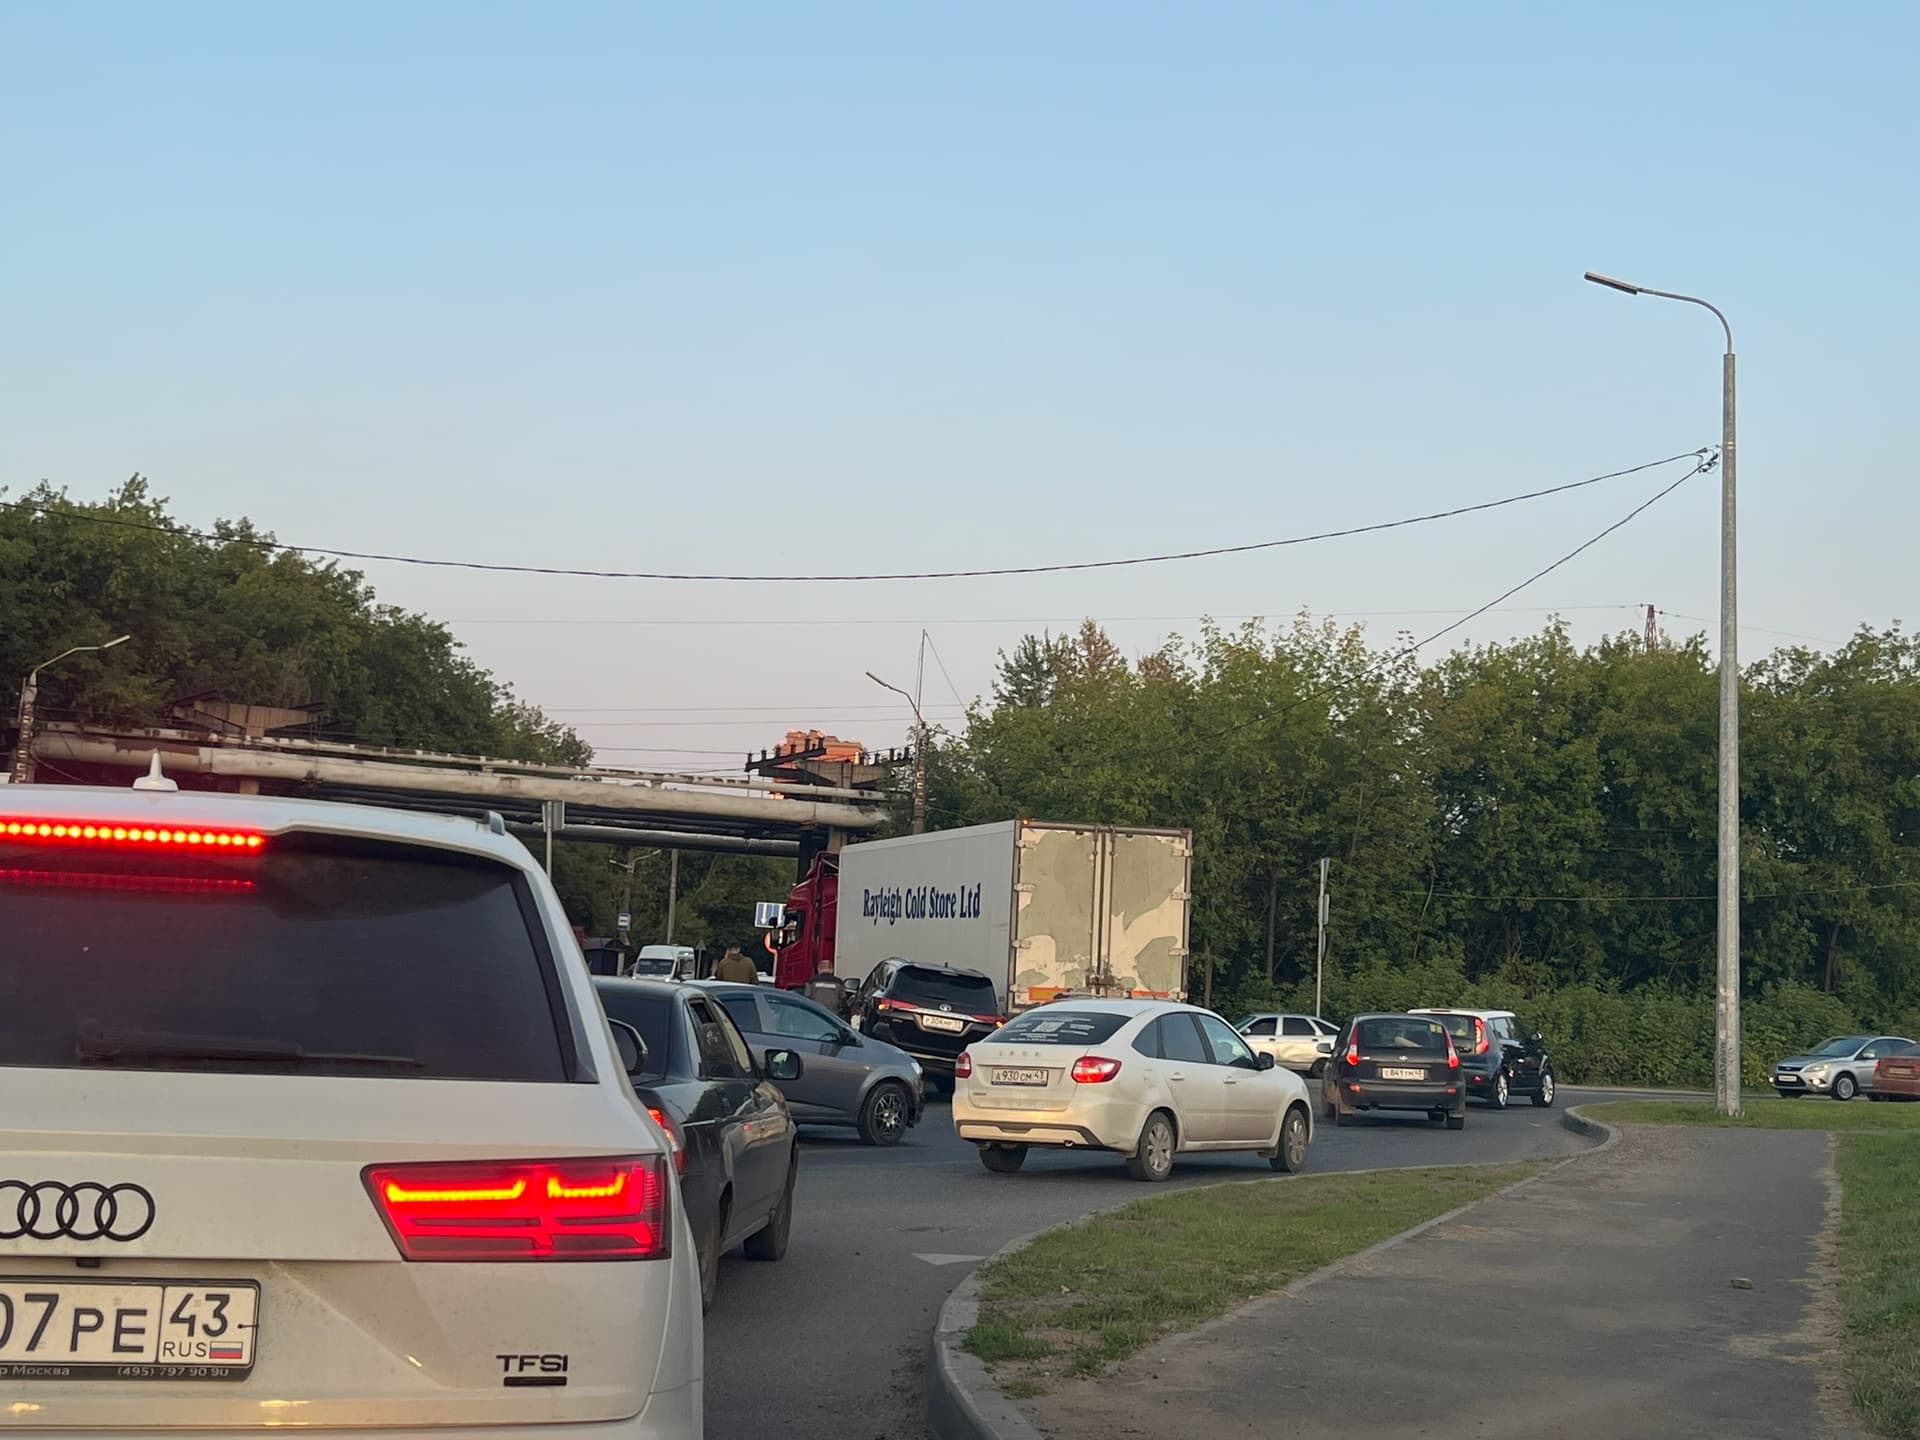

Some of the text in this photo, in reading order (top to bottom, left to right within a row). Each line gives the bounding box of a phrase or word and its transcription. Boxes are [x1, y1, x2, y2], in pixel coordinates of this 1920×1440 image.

[863, 881, 981, 926] Rayleigh Cold Store Ltd
[170, 1293, 231, 1337] 43
[162, 1341, 207, 1358] RUS
[13, 1365, 70, 1376] Москва
[117, 1366, 155, 1377] (495)
[495, 1354, 569, 1372] TFSI
